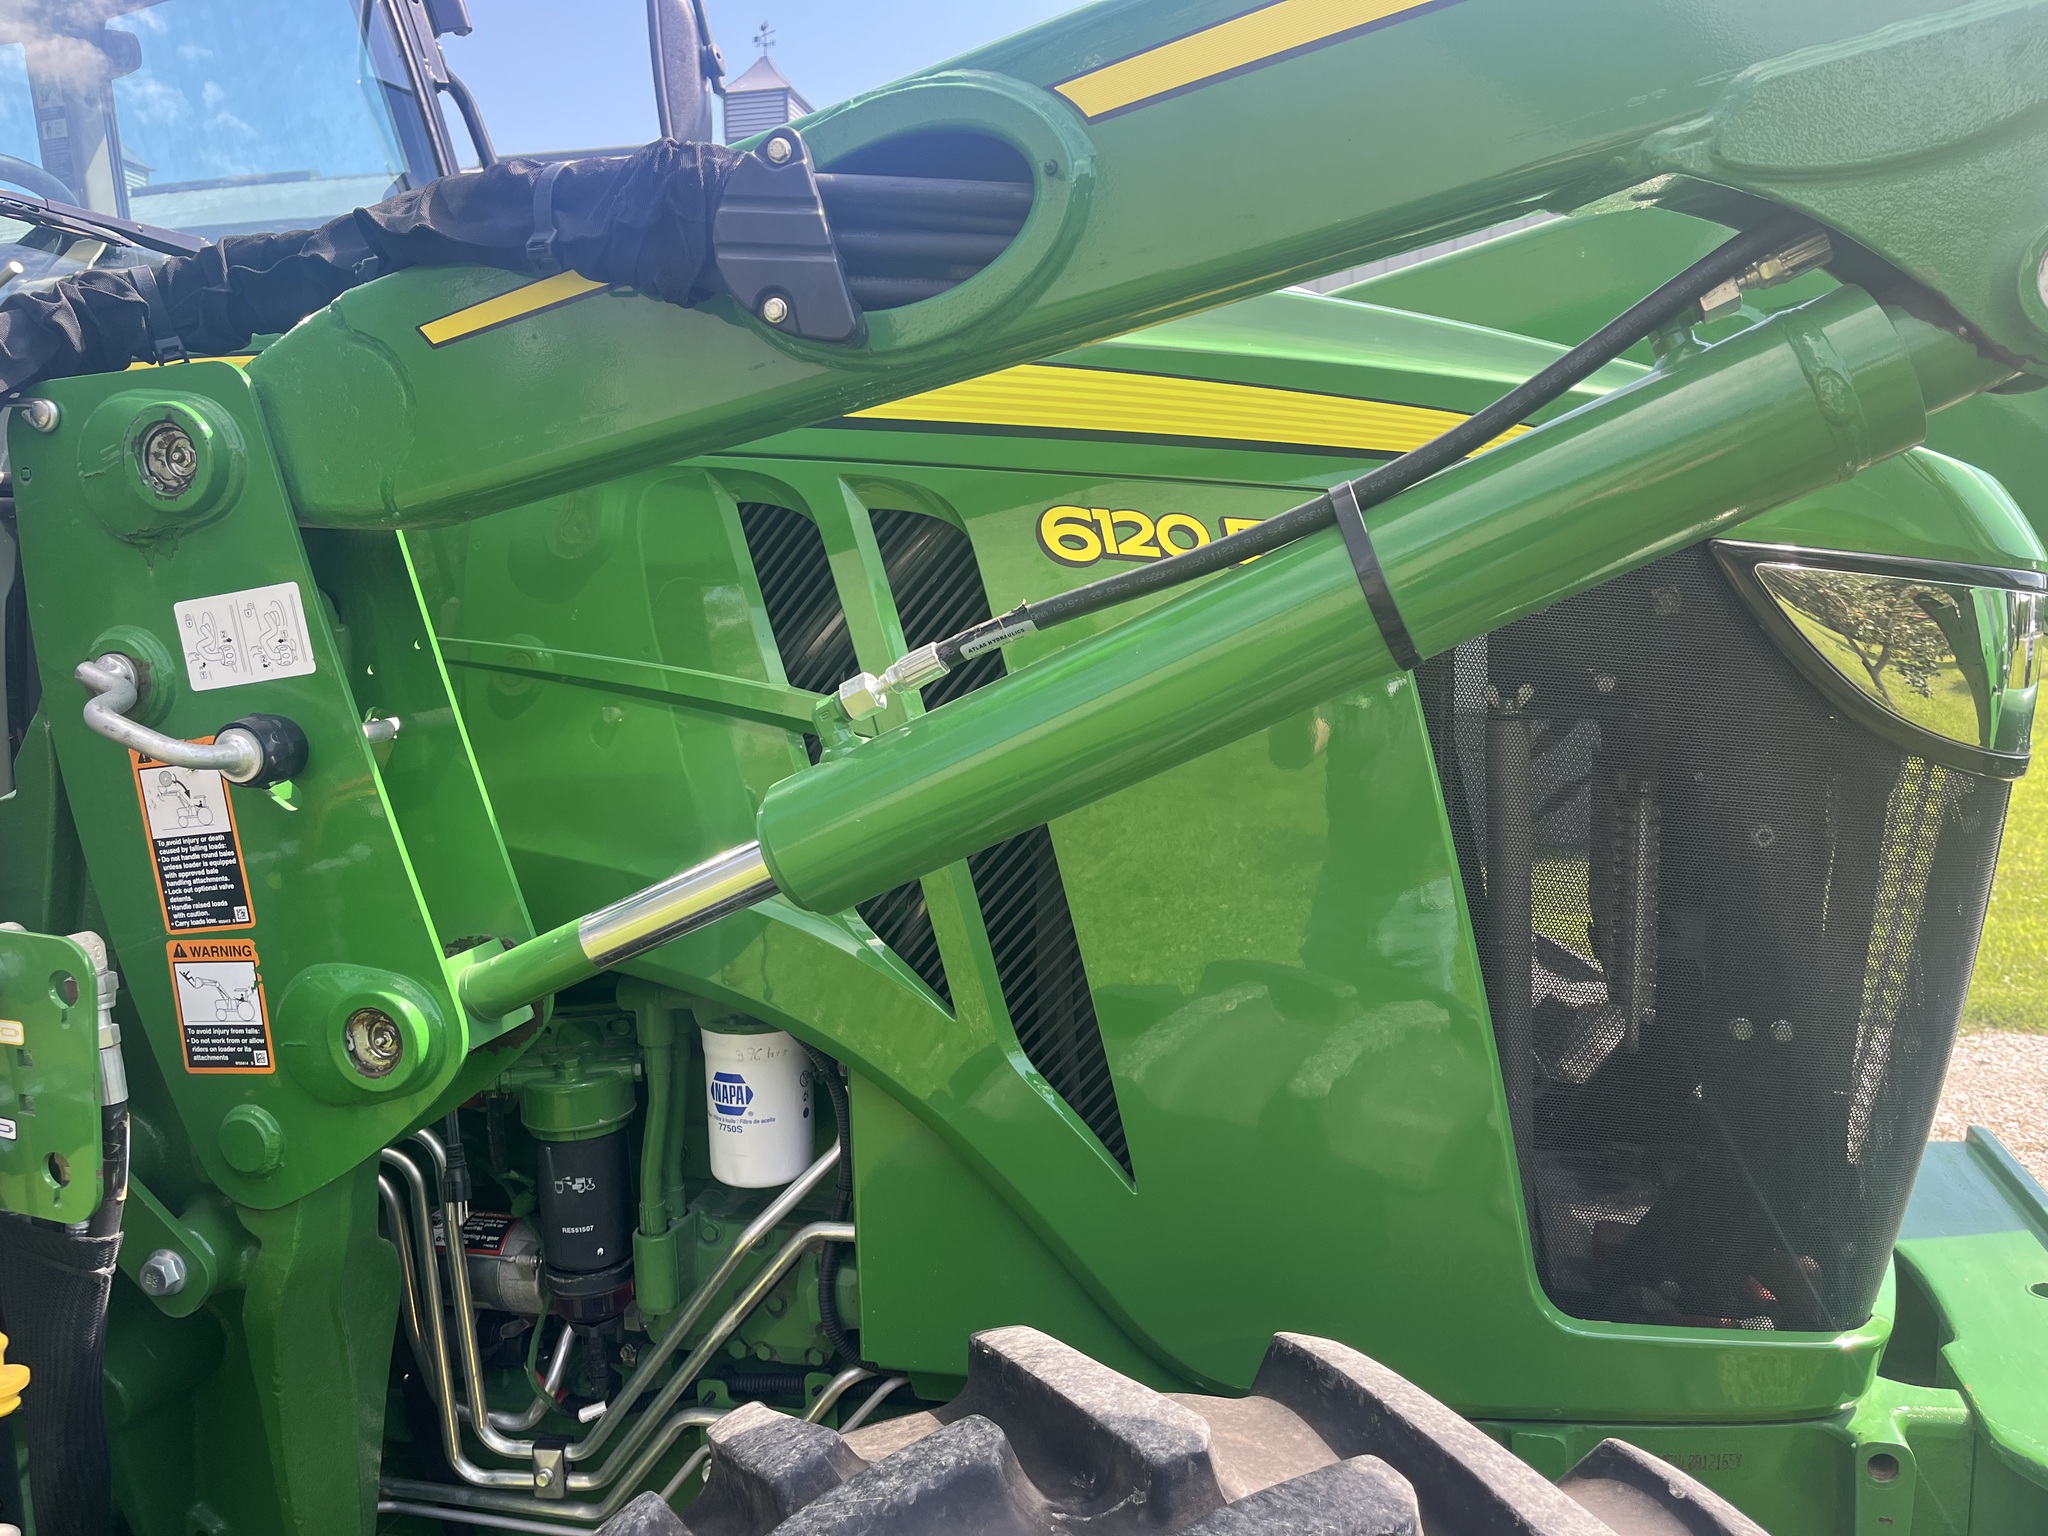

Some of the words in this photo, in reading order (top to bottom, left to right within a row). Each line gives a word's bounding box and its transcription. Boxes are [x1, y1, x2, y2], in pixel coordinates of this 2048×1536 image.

[1267, 523, 1287, 536] SAE
[1036, 505, 1212, 568] 6120
[968, 642, 987, 653] ATLAS
[988, 628, 1025, 645] HYDRAULICS
[166, 838, 181, 847] avoid
[182, 836, 199, 845] injury
[208, 834, 224, 842] death
[159, 847, 180, 855] caused
[189, 844, 207, 852] falling
[181, 853, 200, 861] handle
[209, 858, 237, 867] equipped
[178, 869, 205, 878] approved
[166, 879, 192, 887] handling
[192, 876, 230, 884] attachments.
[194, 885, 218, 893] optional
[169, 895, 193, 903] detents.
[189, 945, 252, 958] WARNING
[212, 1028, 229, 1036] injury
[714, 1082, 745, 1105] NAPA
[718, 1122, 743, 1134] 7750S
[562, 1225, 595, 1233] RE551507
